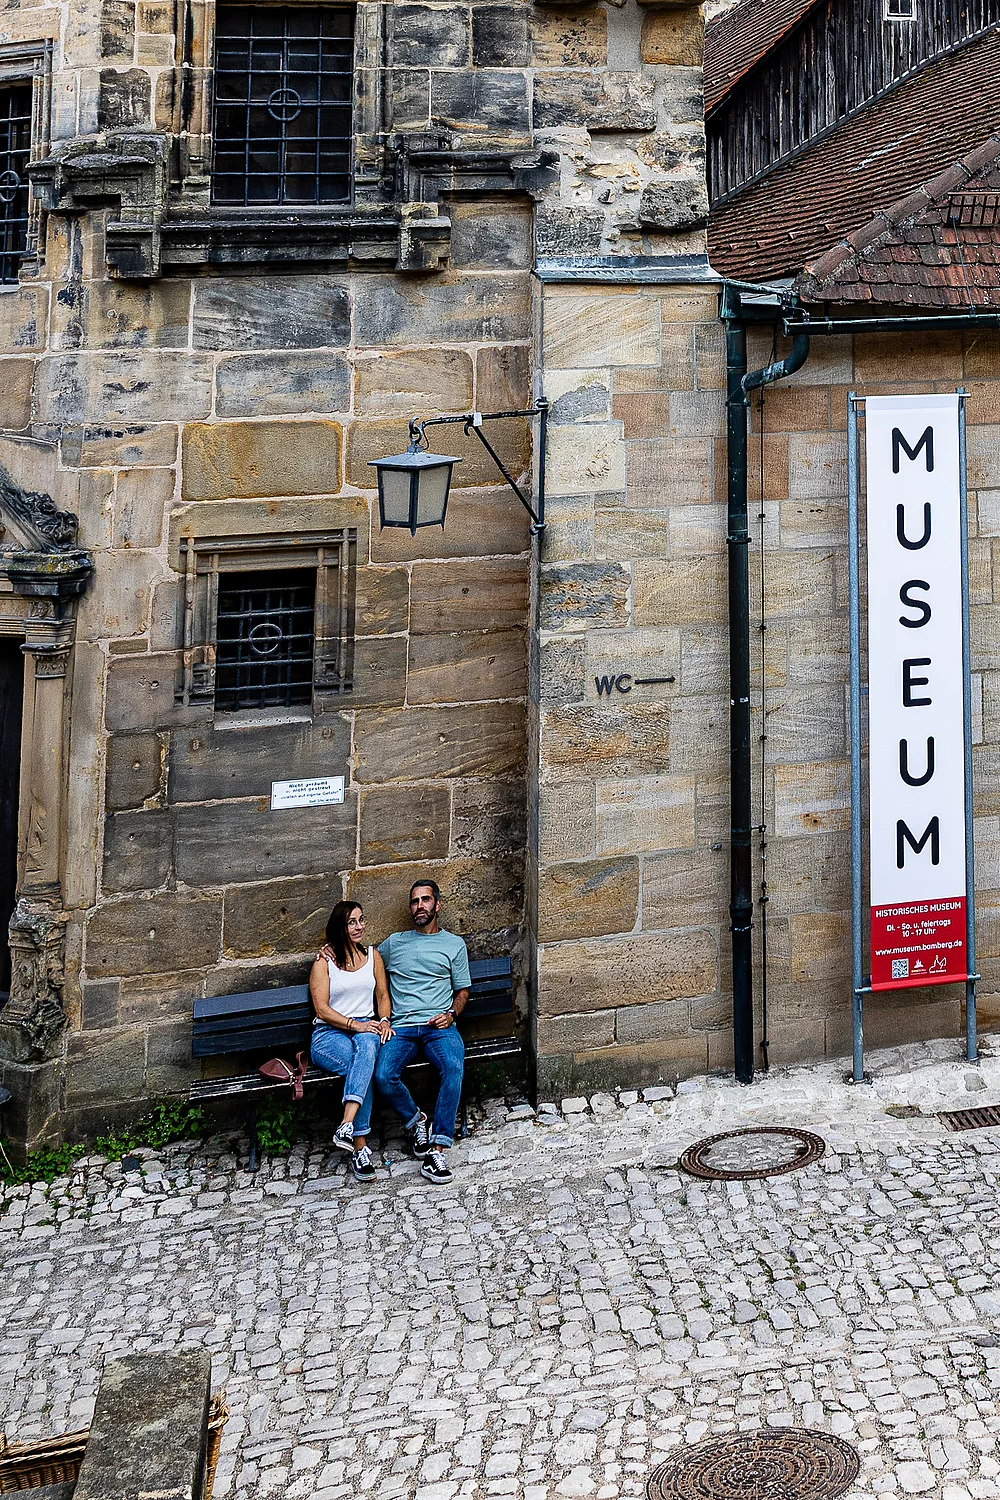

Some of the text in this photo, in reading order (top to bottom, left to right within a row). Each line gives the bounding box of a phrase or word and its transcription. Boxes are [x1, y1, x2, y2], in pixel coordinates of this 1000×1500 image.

[891, 425, 941, 870] MUSEUM
[595, 673, 632, 696] WC
[875, 901, 962, 918] HISTORISCHES MUSEUM
[886, 924, 896, 932] Di.
[921, 919, 951, 928] feiertags
[924, 927, 936, 935] Uhr
[875, 939, 963, 956] www.museum.bamberg.de
